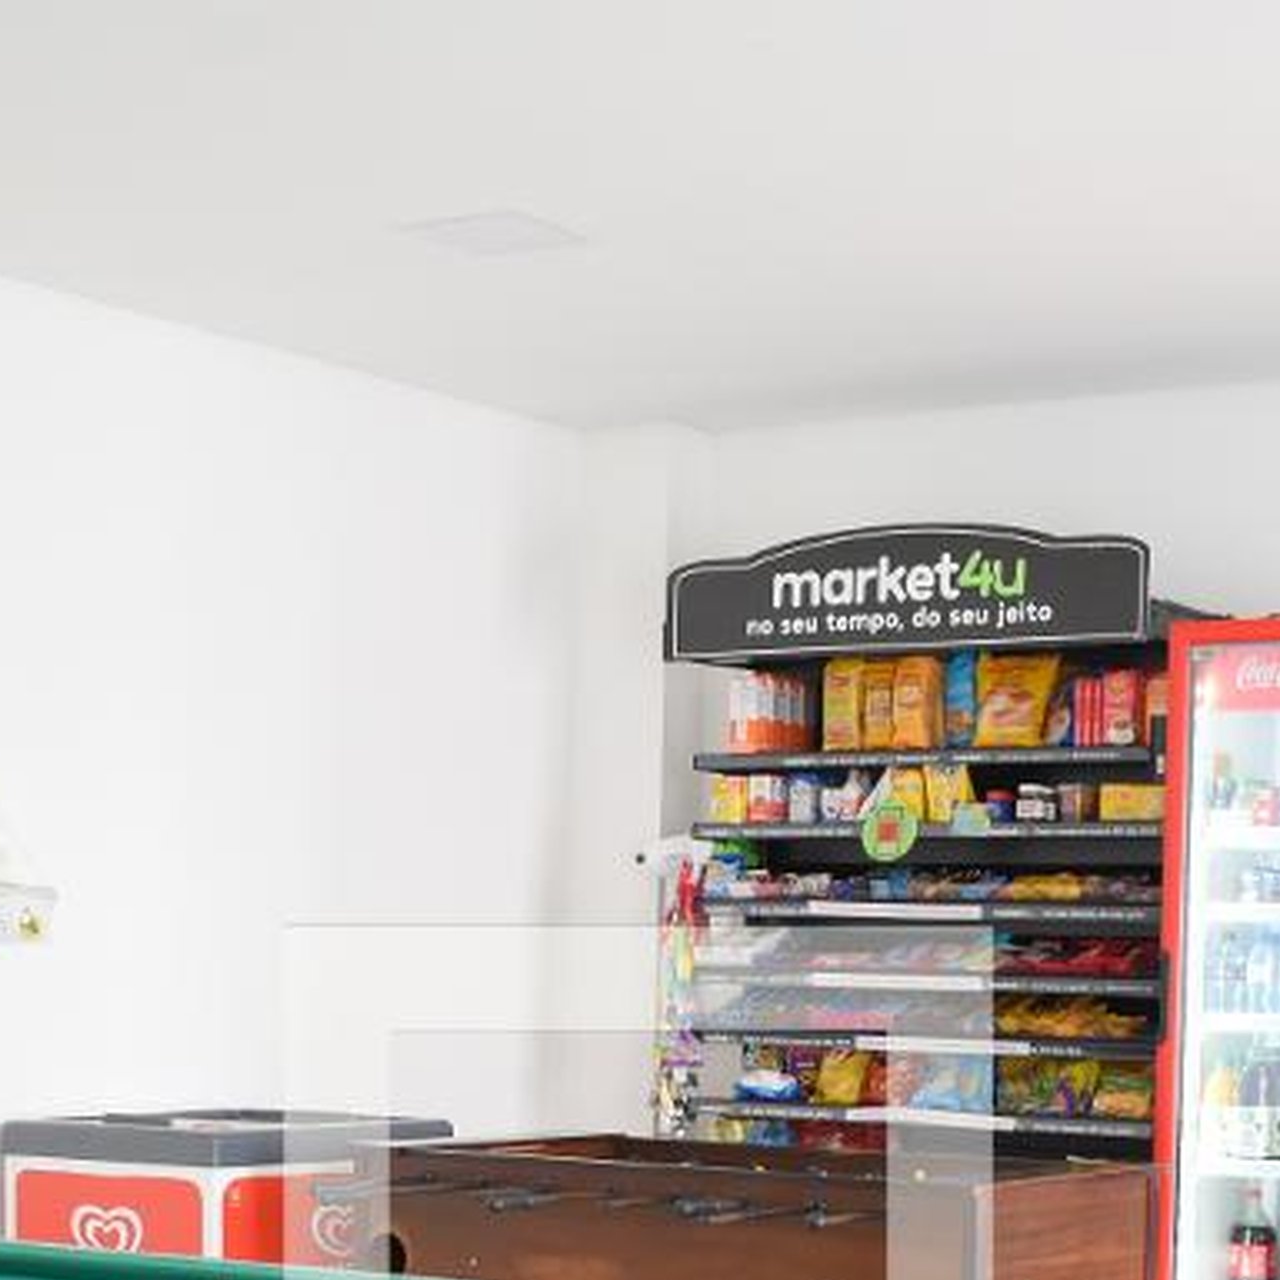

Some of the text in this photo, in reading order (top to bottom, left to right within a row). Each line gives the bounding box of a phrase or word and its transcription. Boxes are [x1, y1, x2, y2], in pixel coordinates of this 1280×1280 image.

[772, 550, 1027, 608] market4u
[745, 601, 1053, 636] no seu tempo, do seu jeito
